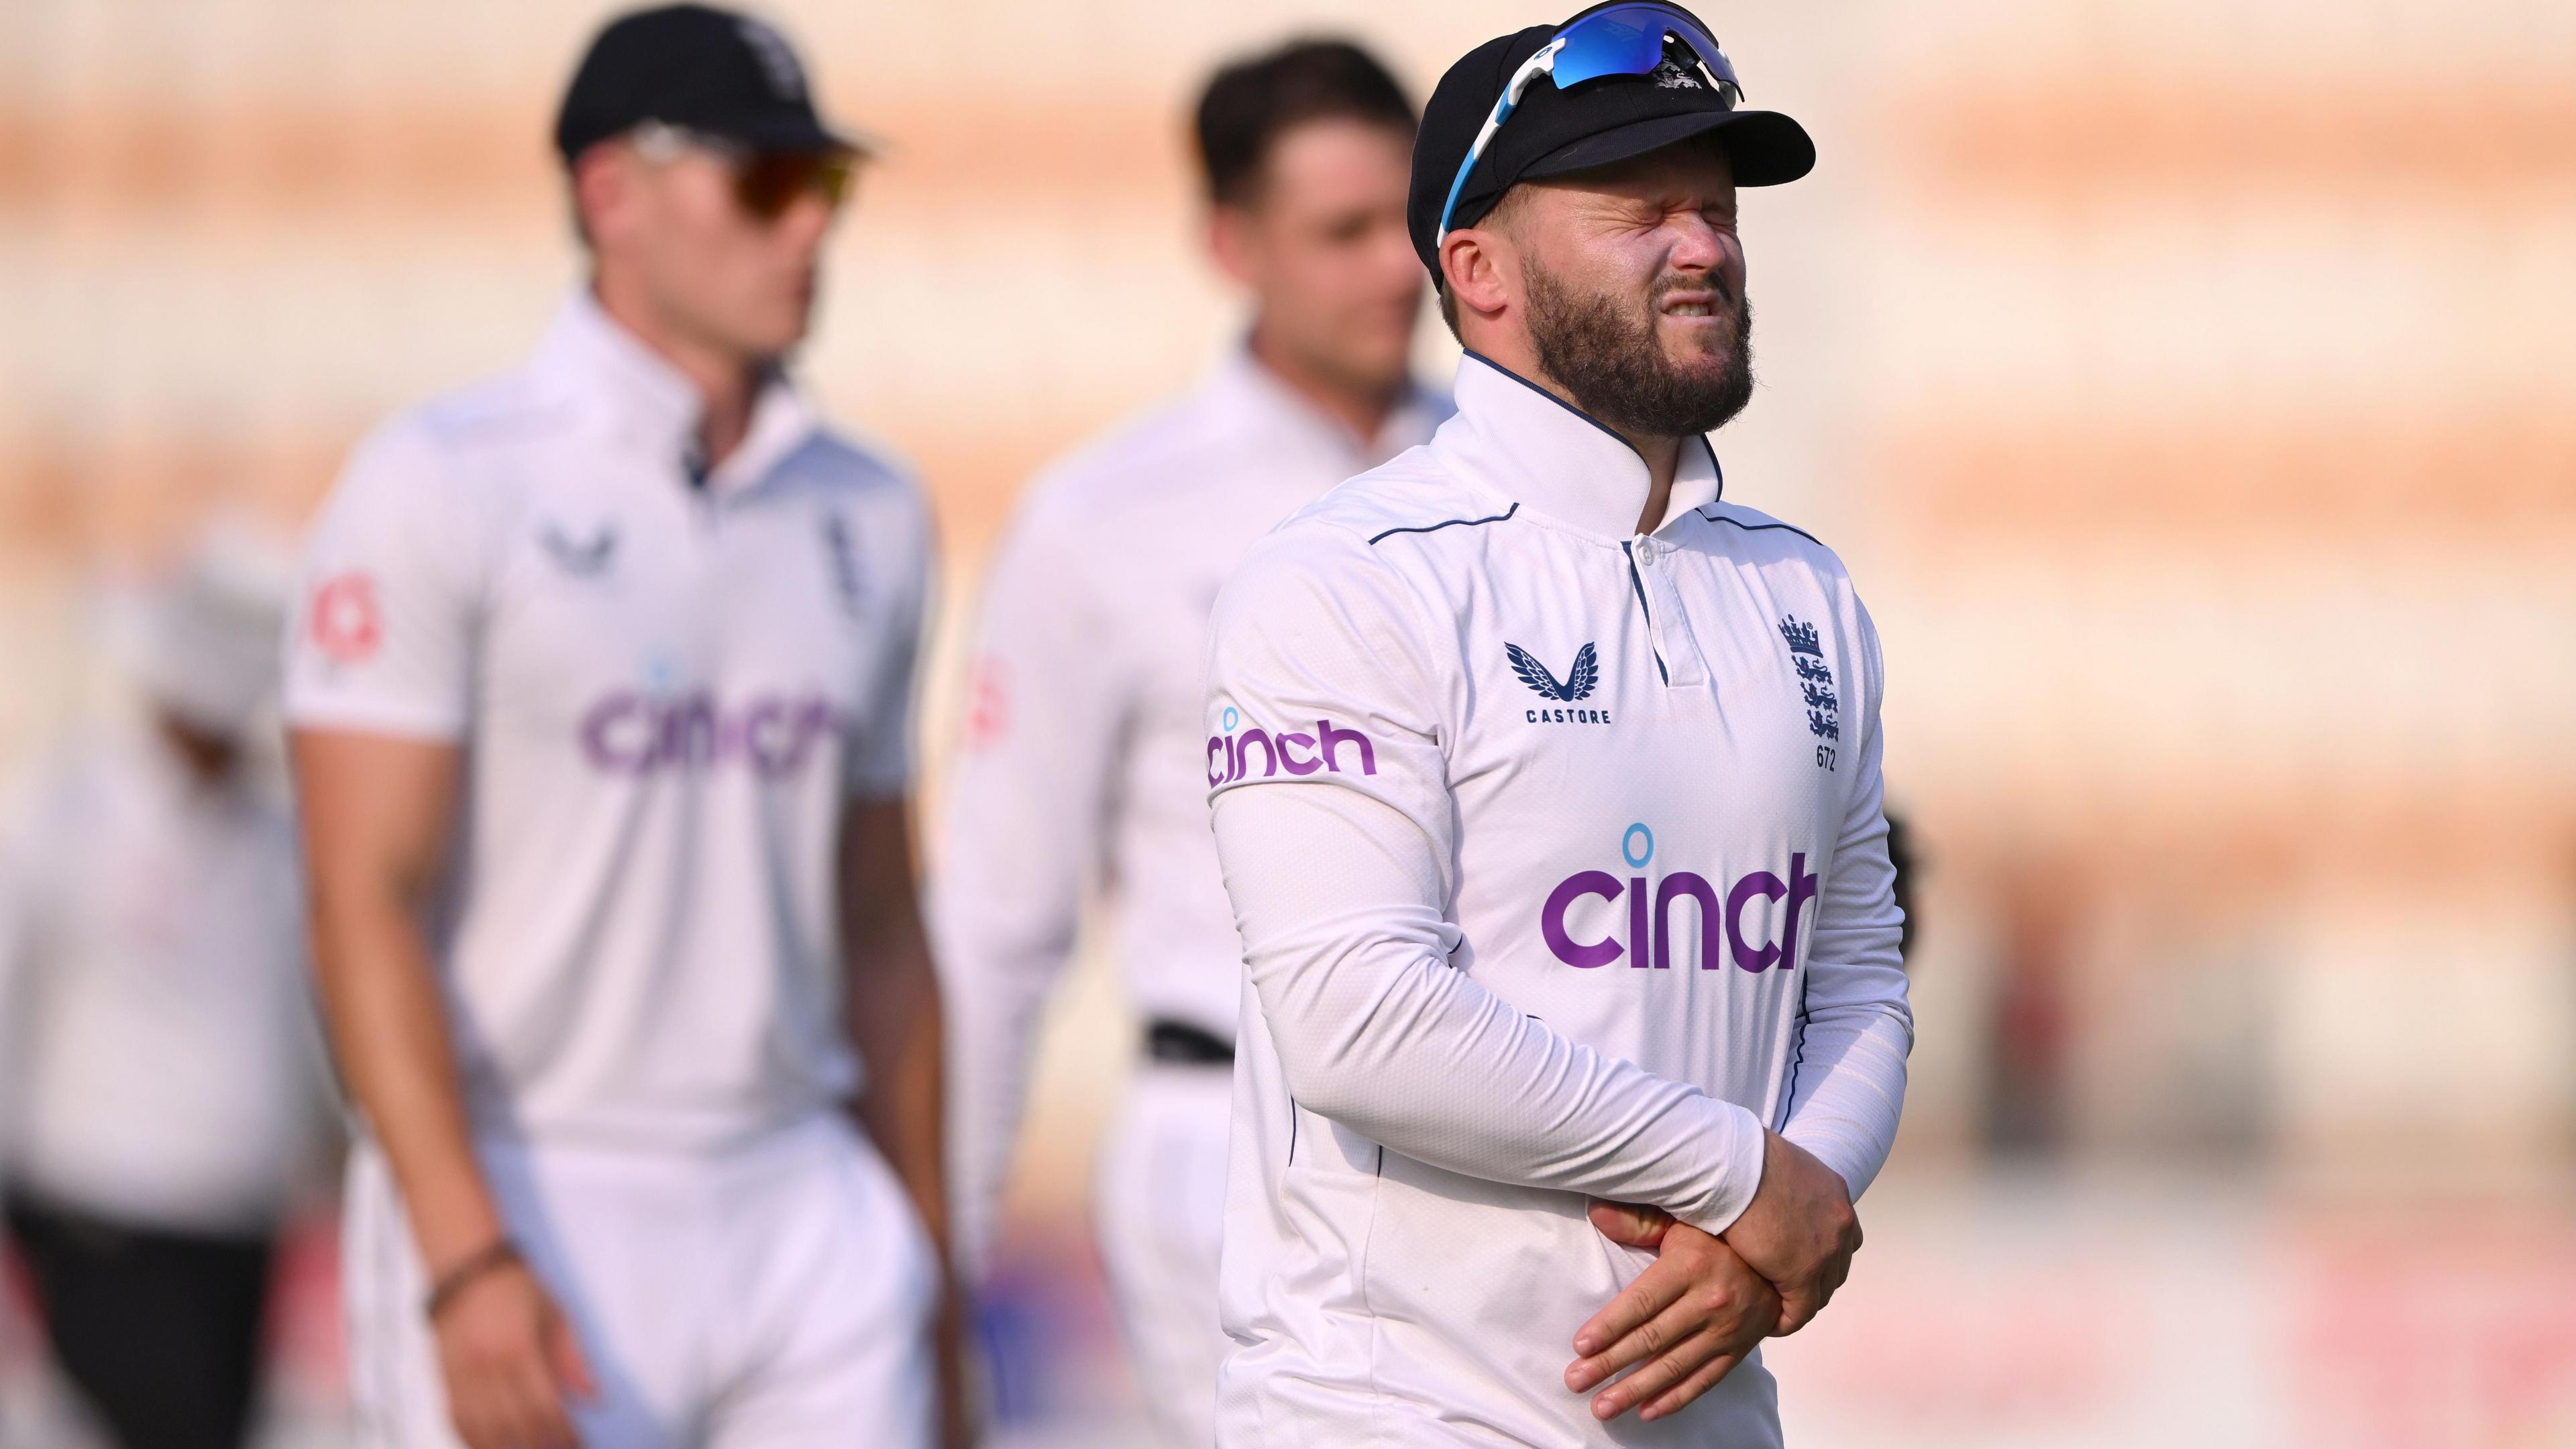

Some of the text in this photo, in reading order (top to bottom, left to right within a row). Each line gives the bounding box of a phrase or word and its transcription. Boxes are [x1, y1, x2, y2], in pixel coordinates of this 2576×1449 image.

[1526, 709, 1611, 724] CASTORE
[1207, 706, 1377, 789] cinch
[1817, 745, 1836, 772] 672
[1542, 822, 1818, 973] cinch
